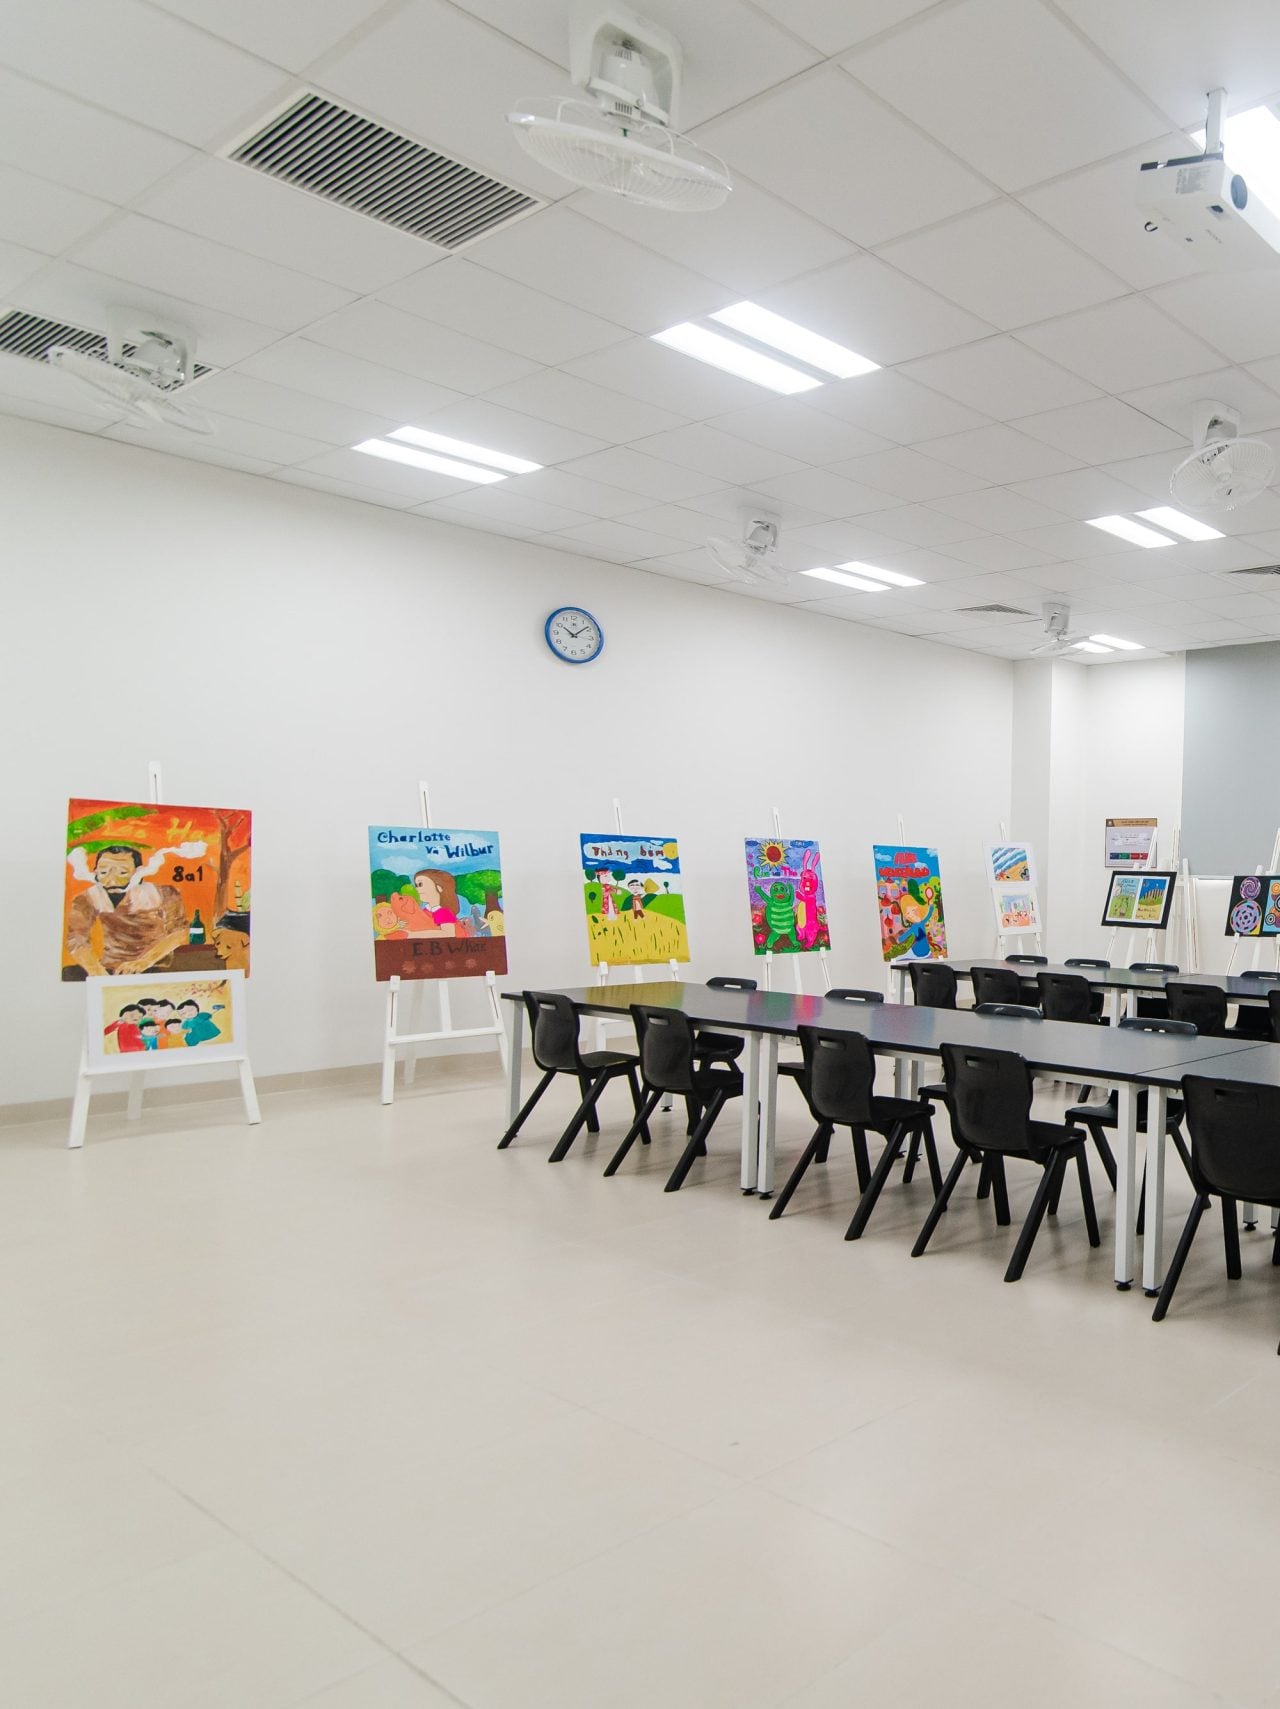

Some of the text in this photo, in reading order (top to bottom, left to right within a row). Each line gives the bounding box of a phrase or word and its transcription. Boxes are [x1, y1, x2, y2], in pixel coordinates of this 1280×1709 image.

[377, 830, 452, 844] Charlotte
[444, 843, 495, 859] Wilbur
[172, 866, 203, 882] 8a1
